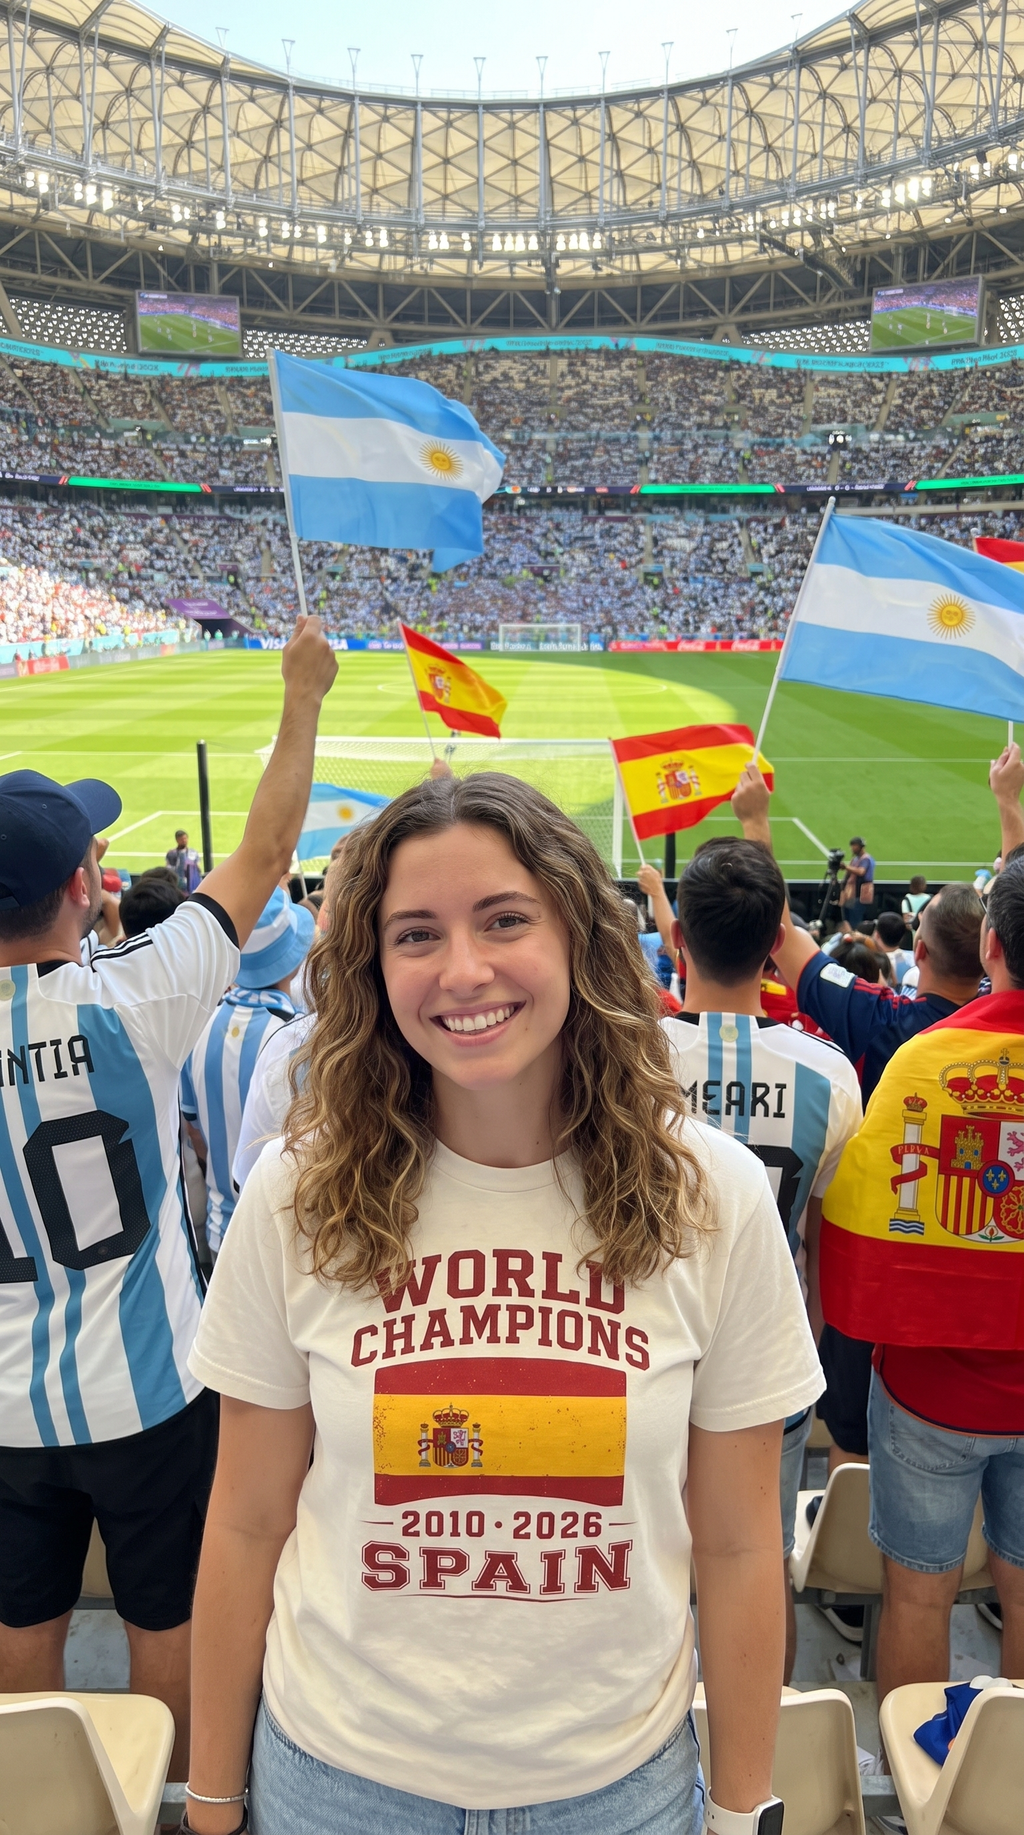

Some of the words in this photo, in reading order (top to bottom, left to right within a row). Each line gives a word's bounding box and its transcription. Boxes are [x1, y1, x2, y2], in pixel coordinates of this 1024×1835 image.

[0, 1034, 95, 1087] NTIA
[374, 1248, 625, 1314] WORLD
[350, 1303, 650, 1371] CHAMPIONS
[401, 1510, 485, 1537] 2010
[512, 1511, 603, 1539] 2026
[361, 1539, 633, 1595] SPAIN
